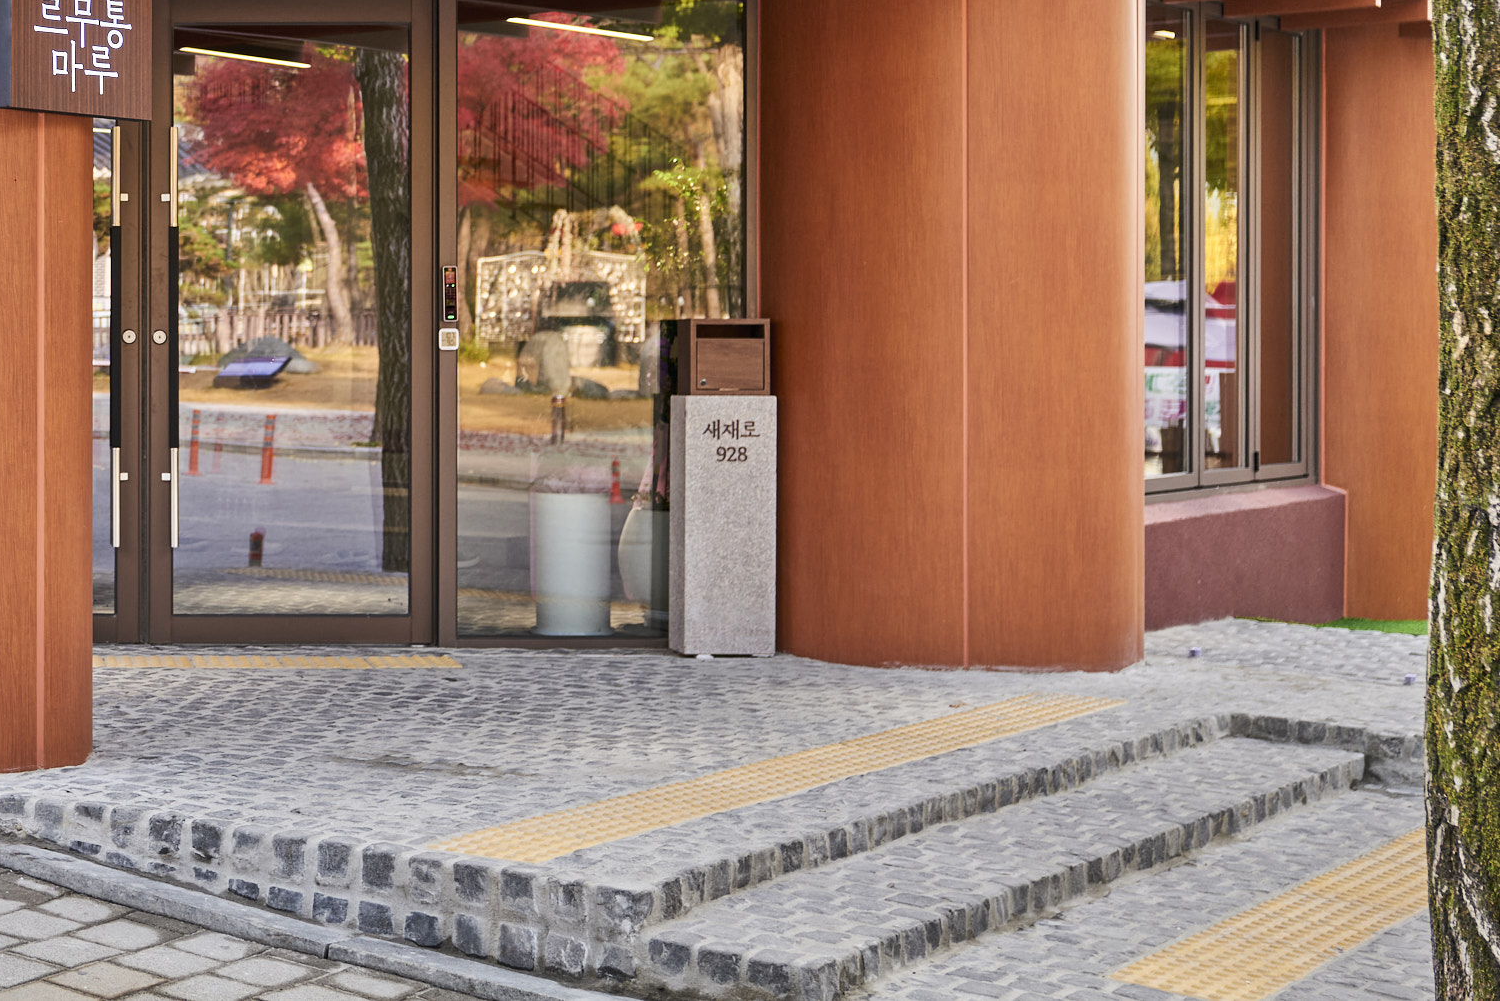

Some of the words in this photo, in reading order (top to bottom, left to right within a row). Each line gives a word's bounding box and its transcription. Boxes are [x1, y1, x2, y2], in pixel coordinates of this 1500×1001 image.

[52, 40, 119, 95] 마루
[702, 419, 761, 440] 새재로
[716, 446, 748, 462] 928
